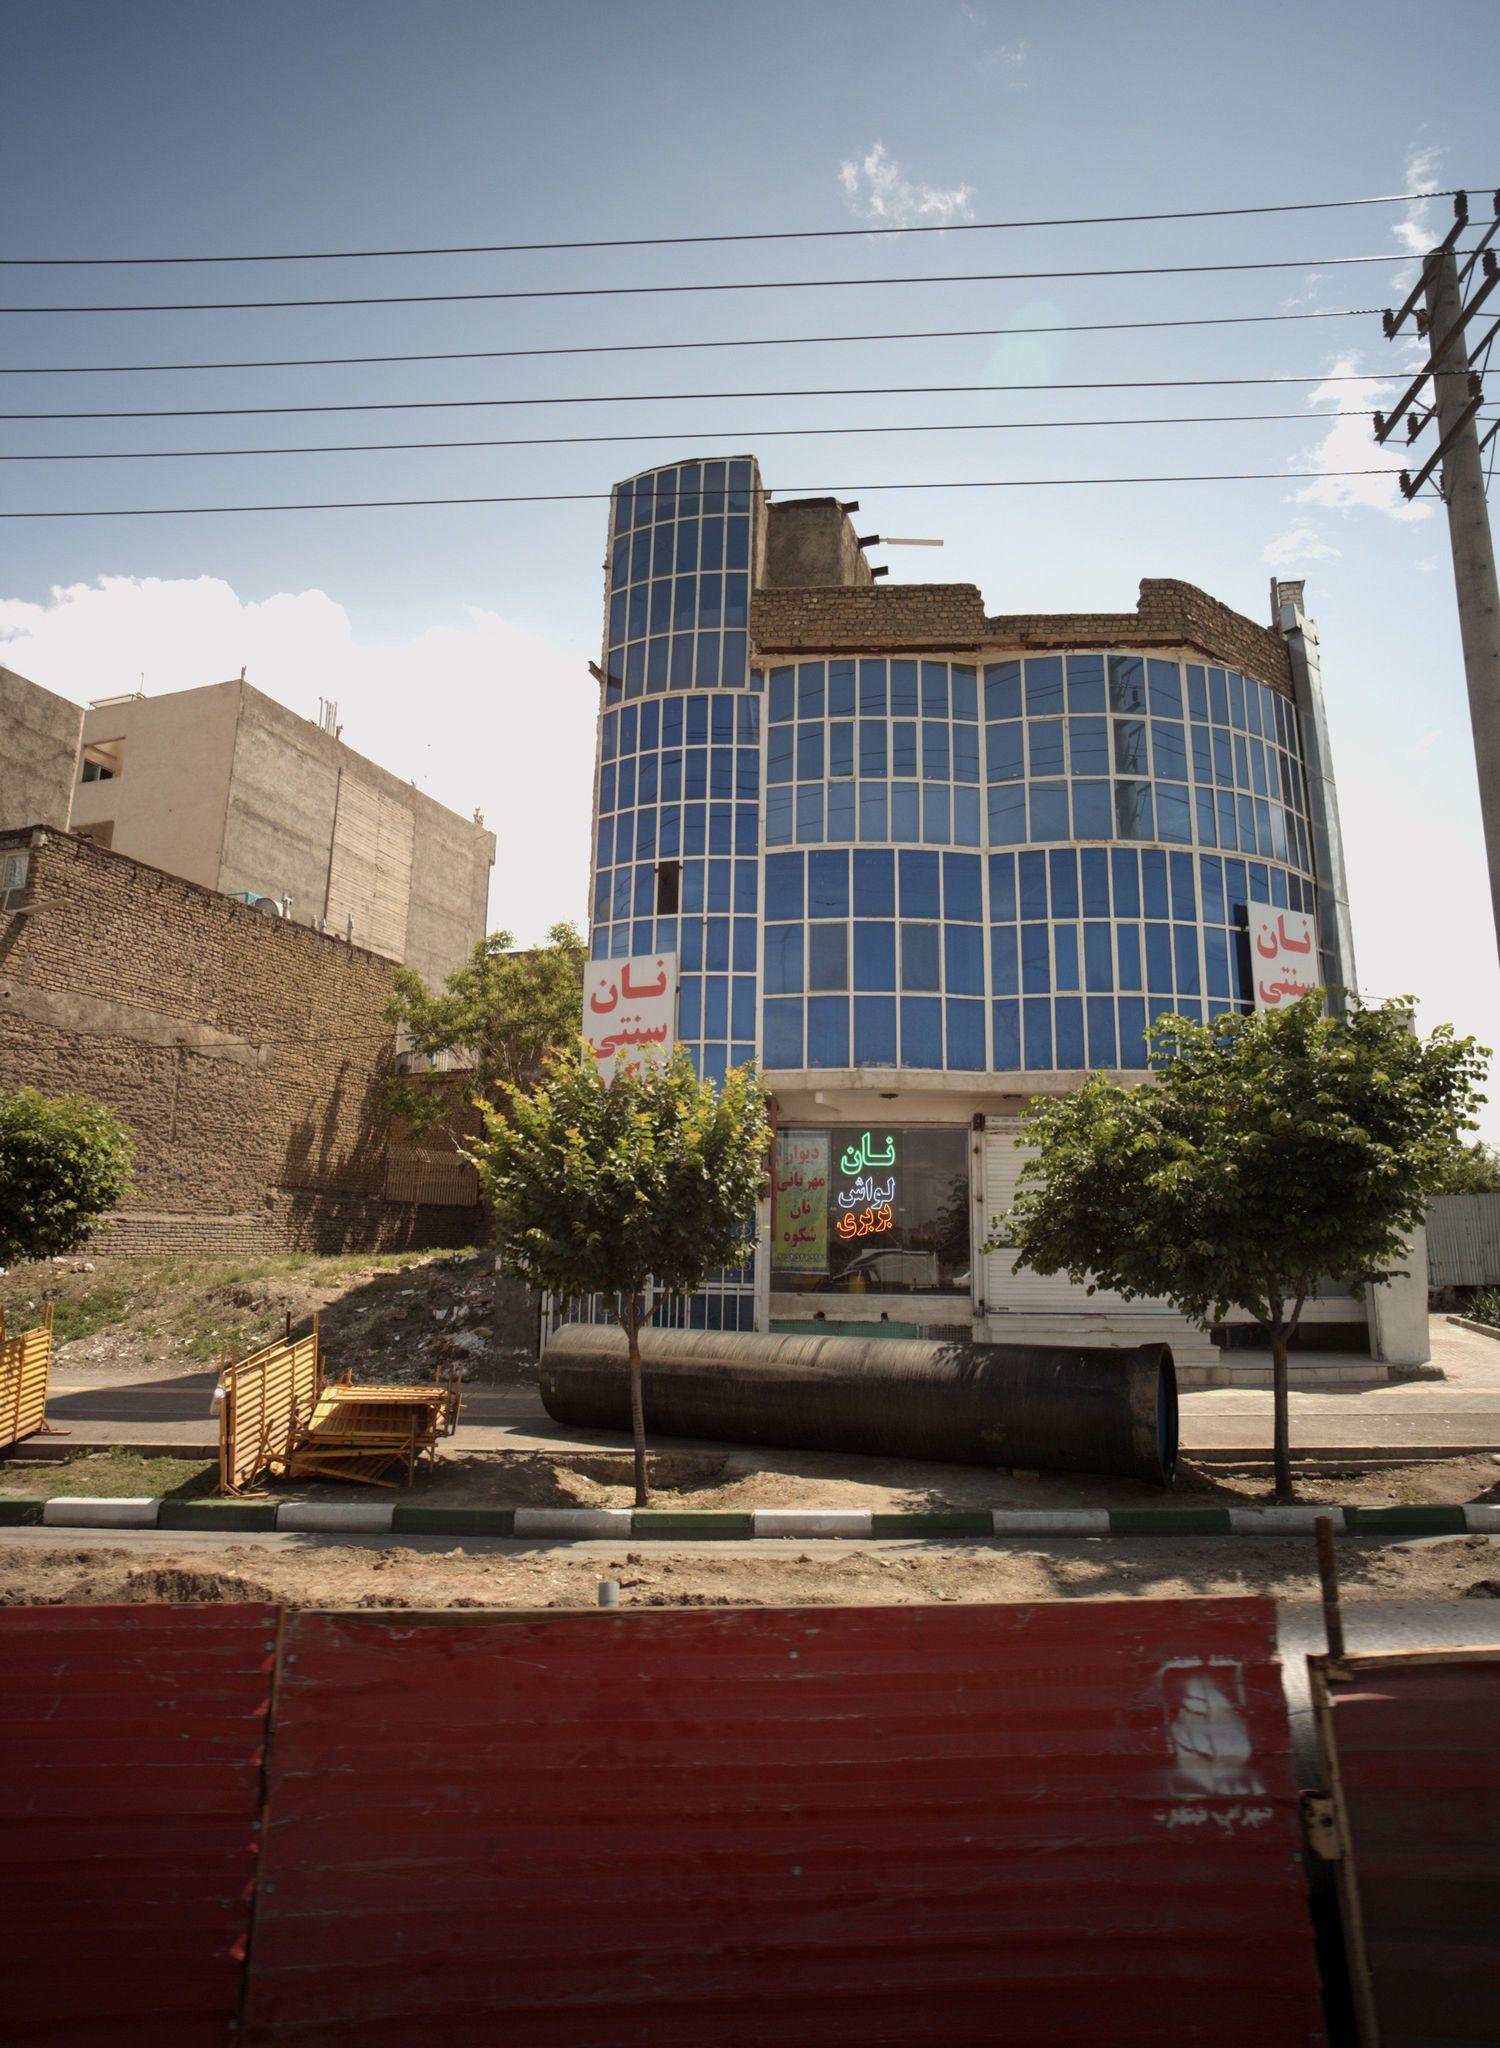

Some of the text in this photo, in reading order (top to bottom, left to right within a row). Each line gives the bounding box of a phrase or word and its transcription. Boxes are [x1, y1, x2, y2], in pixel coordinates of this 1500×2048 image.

[1257, 914, 1311, 959] نان
[590, 959, 667, 1014] نان
[1260, 966, 1316, 1004] سنتی
[588, 1015, 667, 1059] سنتی
[841, 1132, 895, 1175] نان
[777, 1171, 825, 1192] مهربانی
[838, 1176, 896, 1209] لواش
[783, 1227, 817, 1248] شکوه
[836, 1203, 892, 1239] بربری
